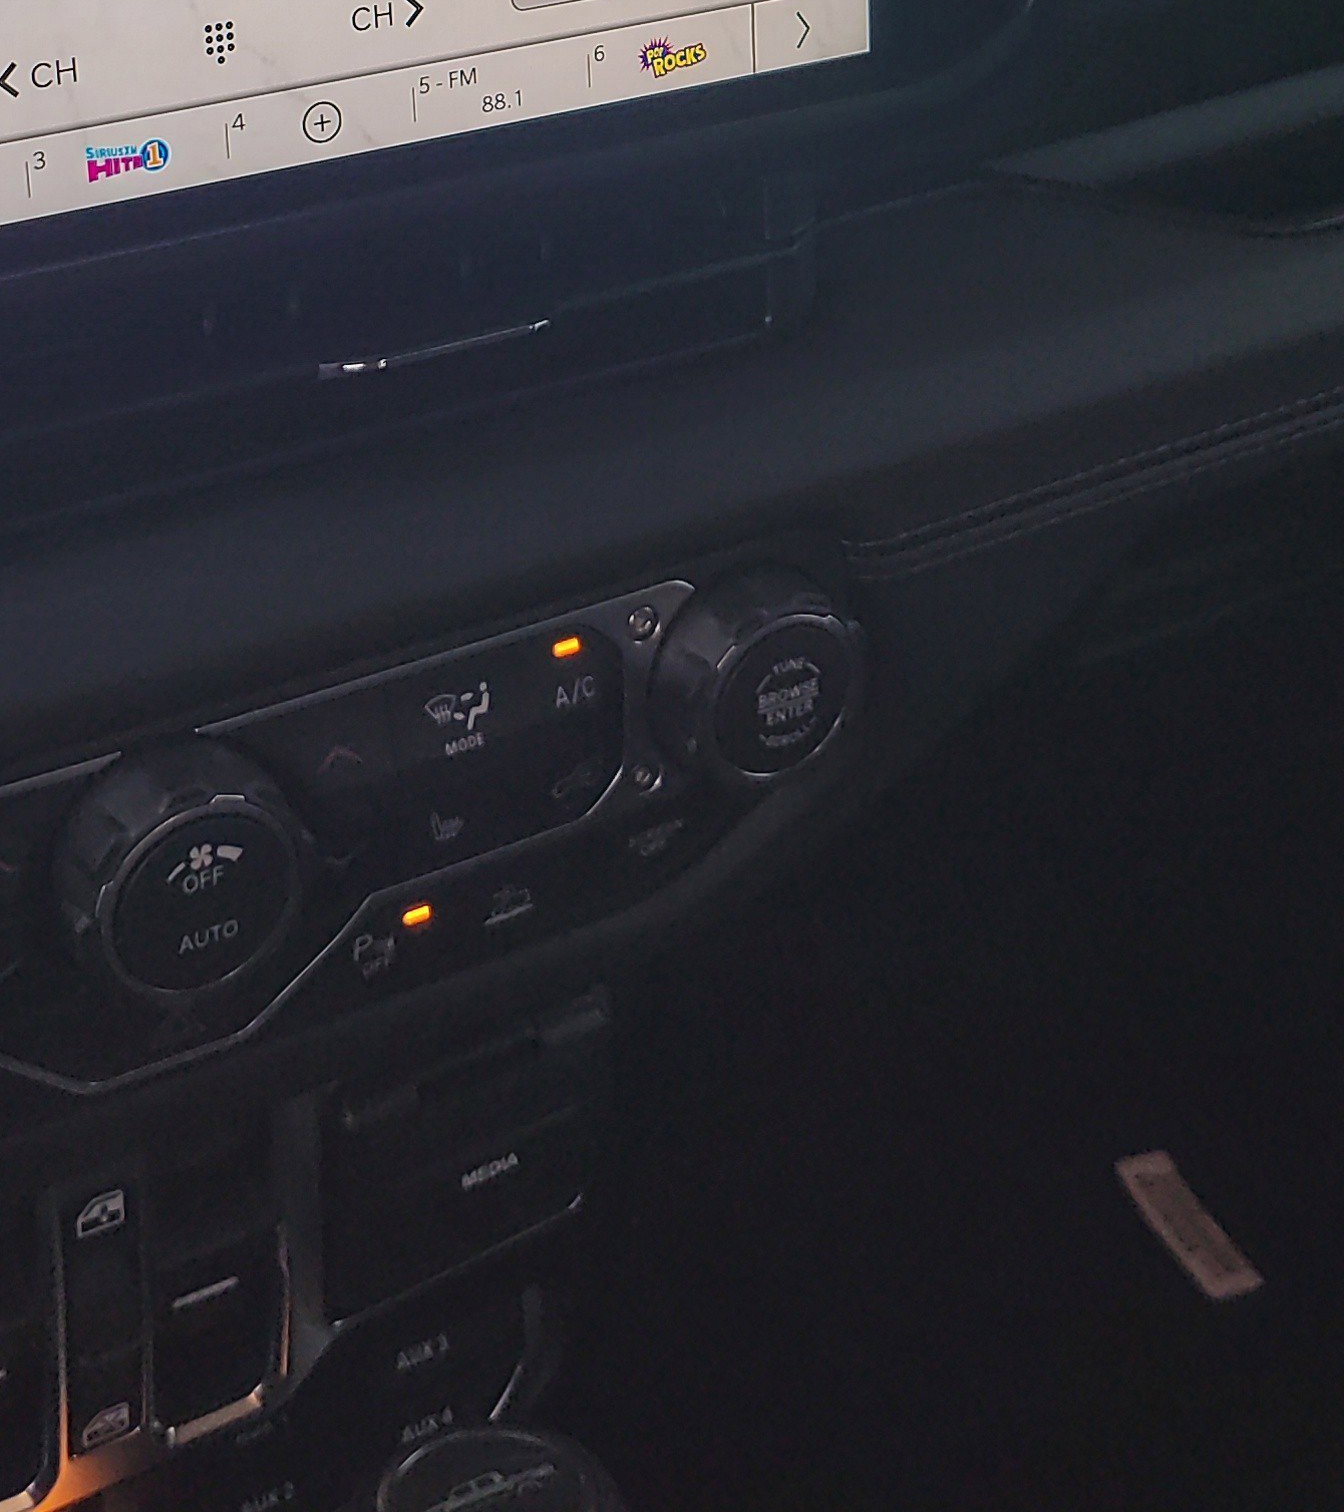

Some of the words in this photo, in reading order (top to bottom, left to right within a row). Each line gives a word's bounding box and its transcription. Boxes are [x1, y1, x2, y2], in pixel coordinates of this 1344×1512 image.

[351, 1, 394, 33] CH
[594, 44, 605, 62] 6
[652, 44, 706, 78] ROCKS
[30, 56, 79, 89] CH
[419, 76, 431, 95] 5
[448, 67, 478, 89] FM
[481, 89, 523, 114] 88.1
[232, 113, 246, 131] 4
[33, 150, 46, 170] 3
[555, 674, 596, 709] A/C
[758, 677, 819, 710] BROWSE
[765, 698, 814, 726] ENTER
[445, 731, 487, 756] MODE
[181, 865, 226, 895] OFF
[177, 919, 241, 956] AUTO
[460, 1152, 519, 1191] MEDIA
